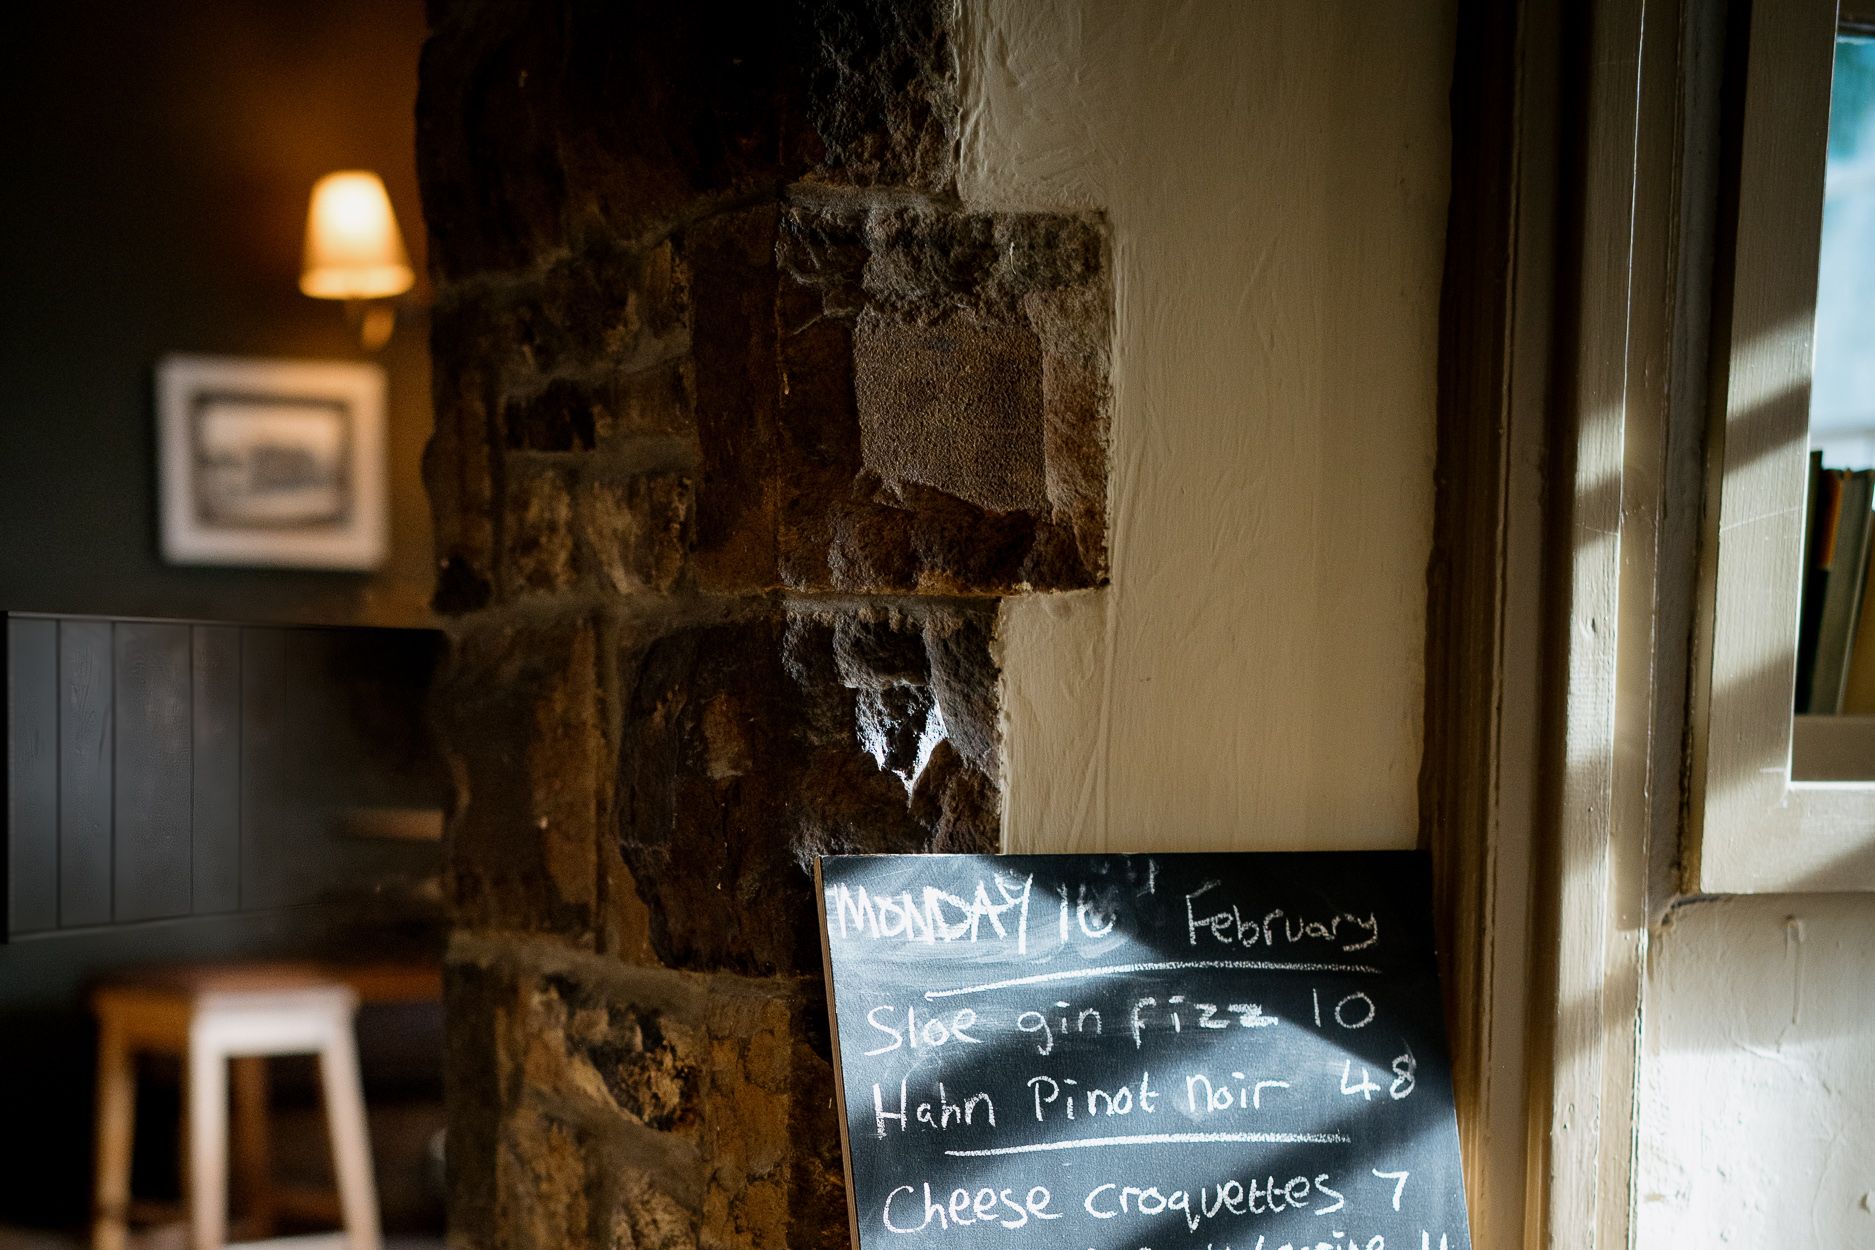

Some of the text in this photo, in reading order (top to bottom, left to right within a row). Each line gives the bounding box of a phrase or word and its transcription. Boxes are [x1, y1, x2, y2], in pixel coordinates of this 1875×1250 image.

[832, 872, 1034, 955] MONDAY
[1185, 880, 1377, 951] February
[864, 1005, 983, 1055] Sloe
[1017, 1001, 1102, 1056] gin
[1312, 988, 1376, 1030] 10
[873, 1082, 996, 1140] Hahn
[1027, 1071, 1160, 1122] Pinot
[1340, 1053, 1418, 1101] 48
[882, 1184, 1063, 1235] Cheese
[1371, 1168, 1410, 1213] 7
